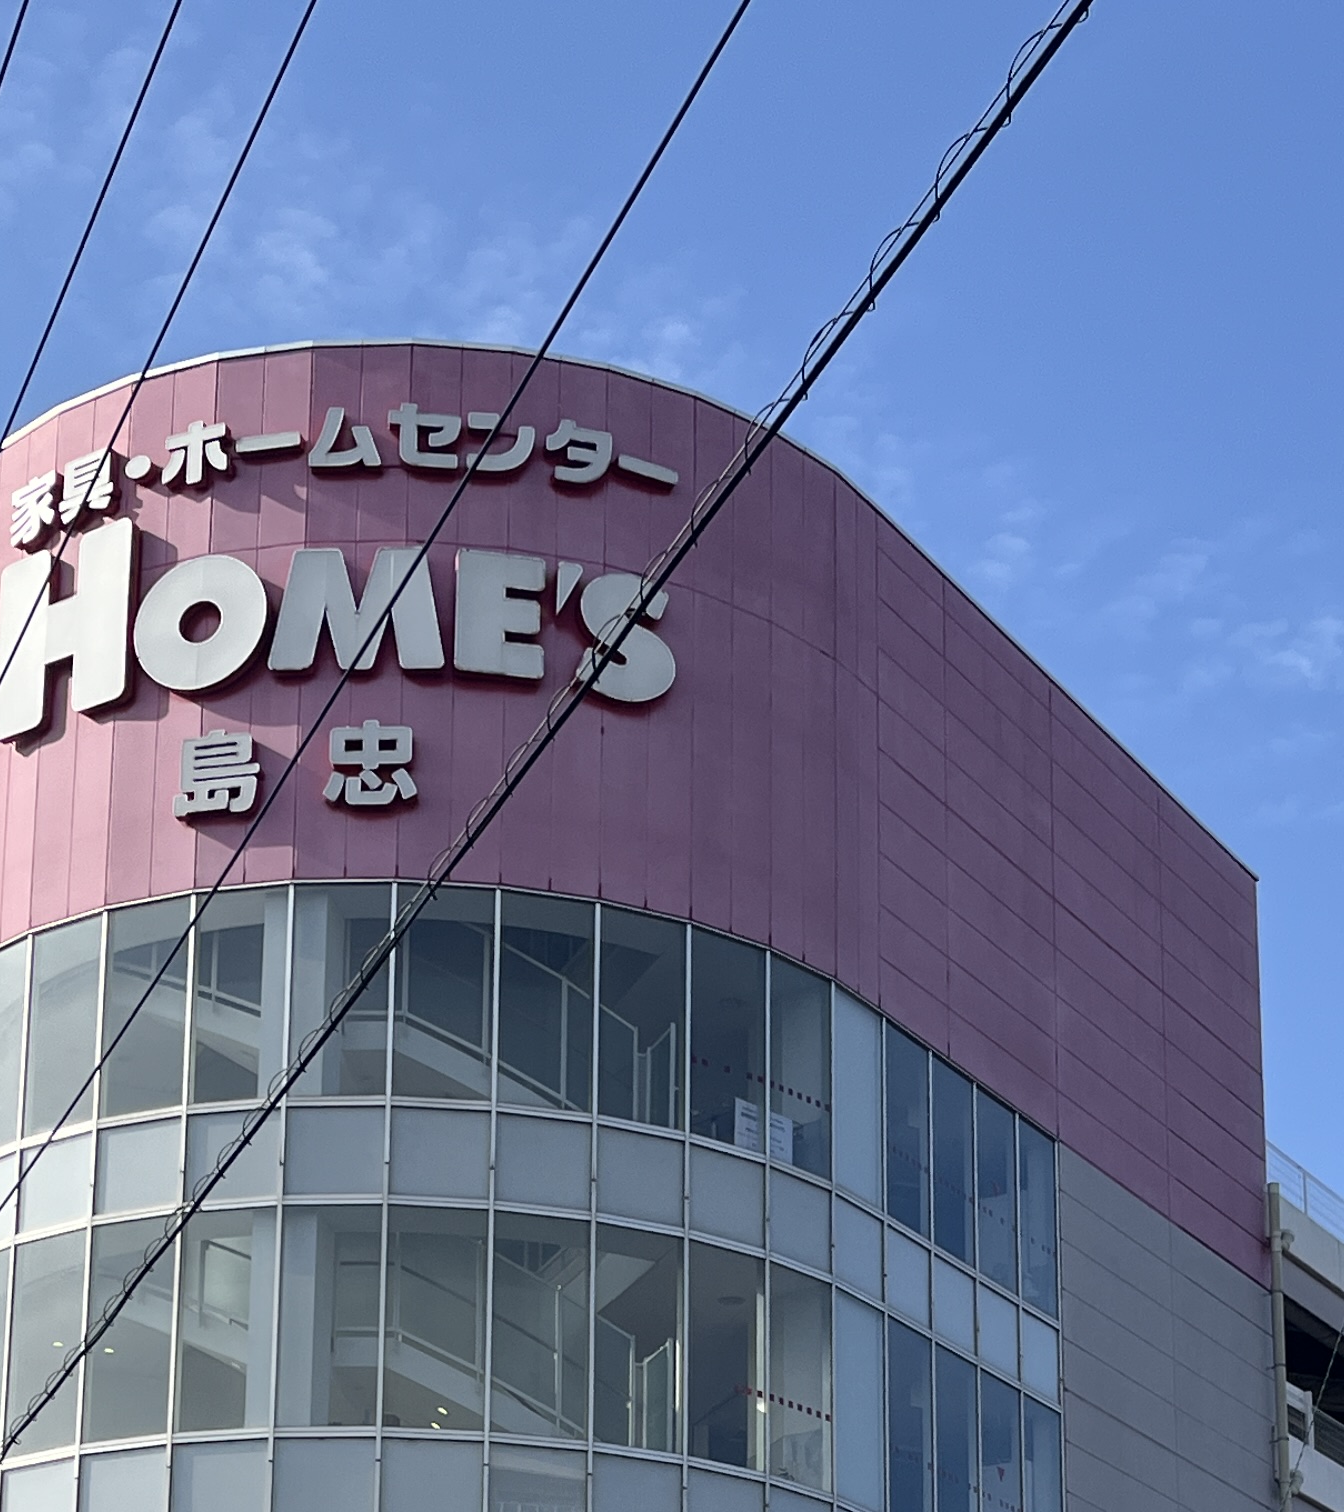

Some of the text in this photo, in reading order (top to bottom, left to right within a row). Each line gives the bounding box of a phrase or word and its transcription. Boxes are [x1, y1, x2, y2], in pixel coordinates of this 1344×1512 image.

[9, 402, 679, 550] 家具・ホームセンター
